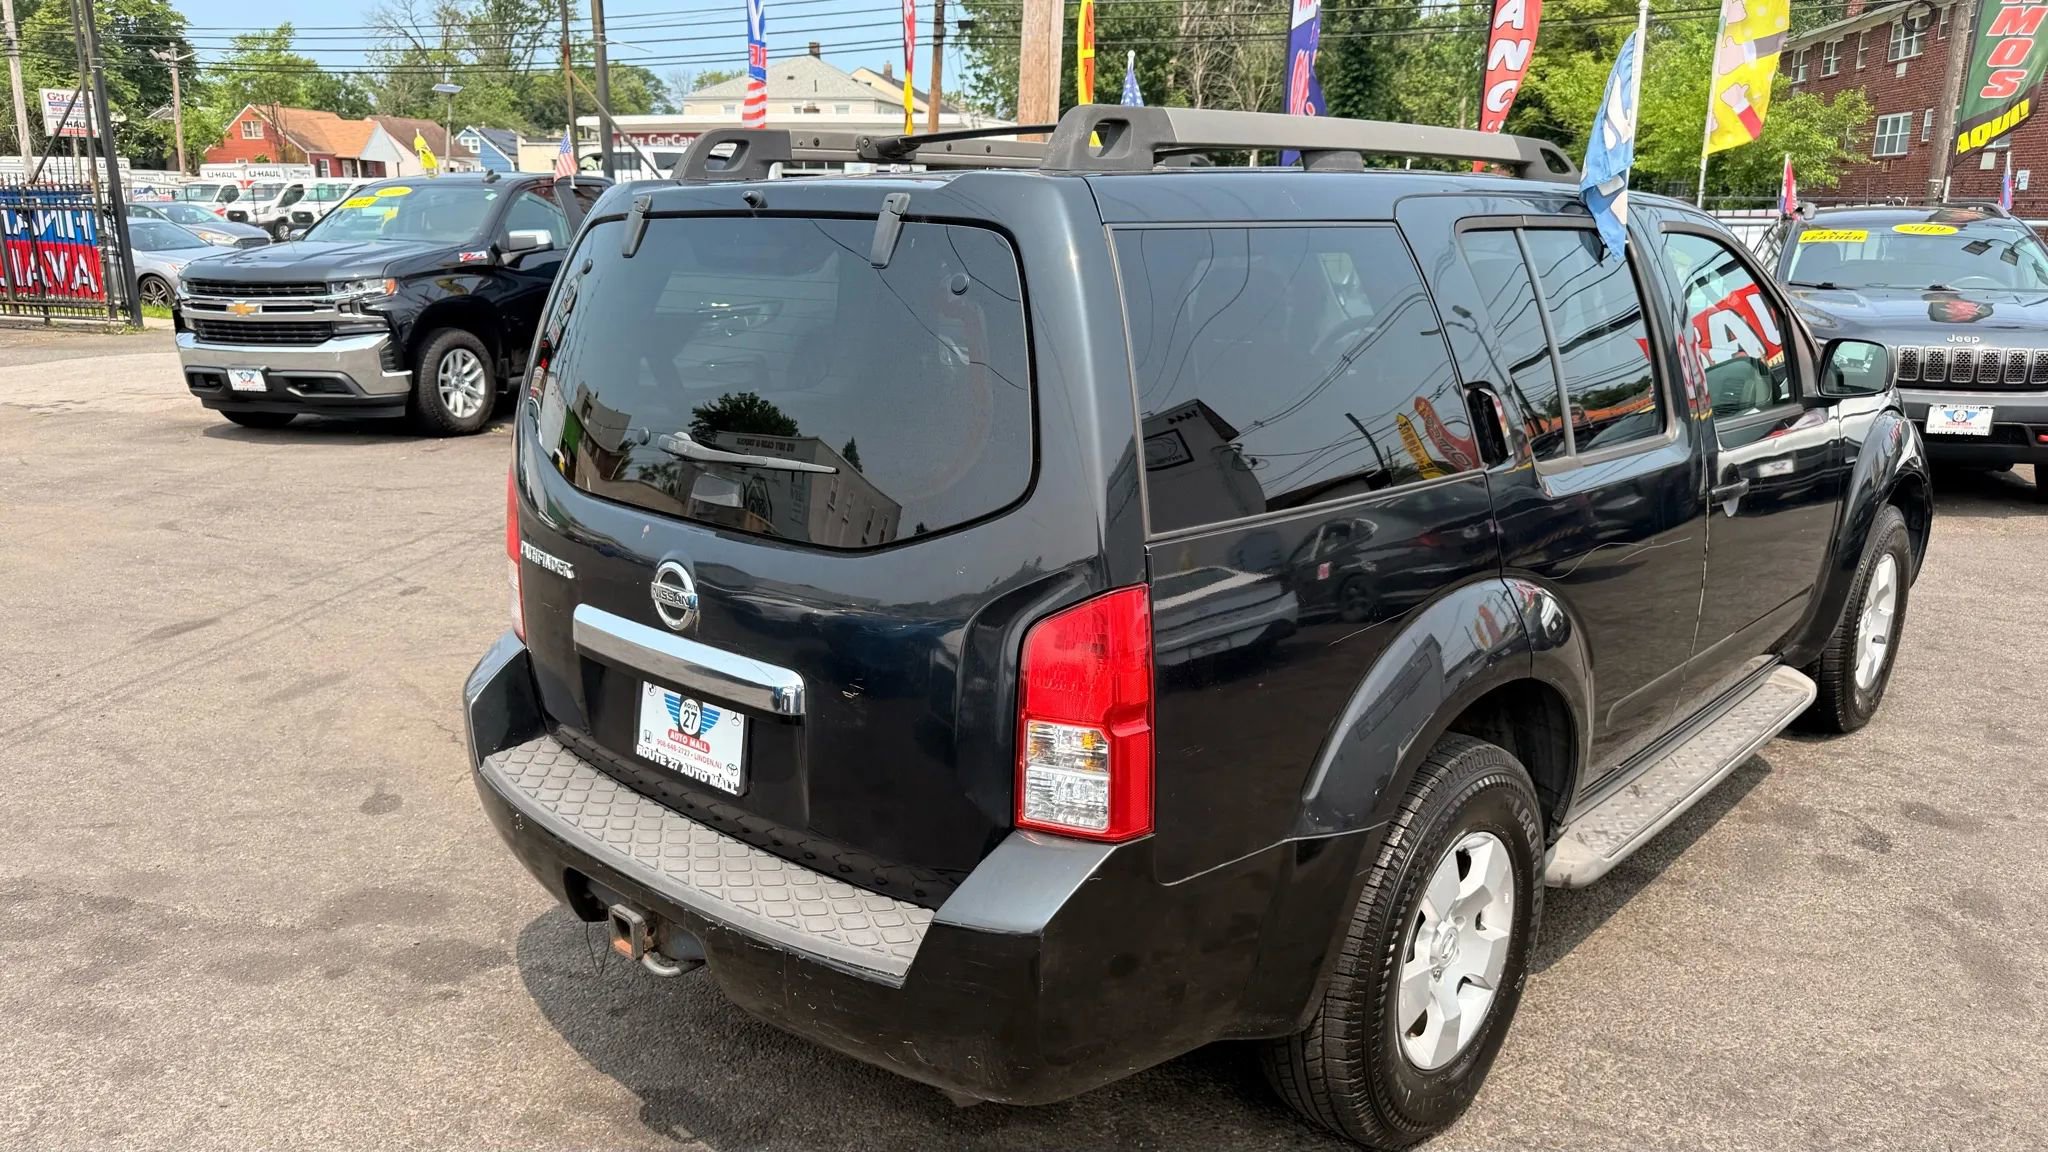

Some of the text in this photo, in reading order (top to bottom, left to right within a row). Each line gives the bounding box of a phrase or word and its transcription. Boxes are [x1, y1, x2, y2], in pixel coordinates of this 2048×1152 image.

[1980, 0, 2048, 98] MOS
[1955, 98, 2030, 156] AQUI!
[648, 133, 695, 146] CarCar
[1946, 333, 1980, 344] Jeep
[653, 587, 690, 606] NISSAN
[683, 702, 698, 711] ROUTE
[682, 709, 697, 730] 27
[670, 731, 708, 753] AUTO MALL
[636, 744, 738, 795] ROUTE 27 AUTO MALL
